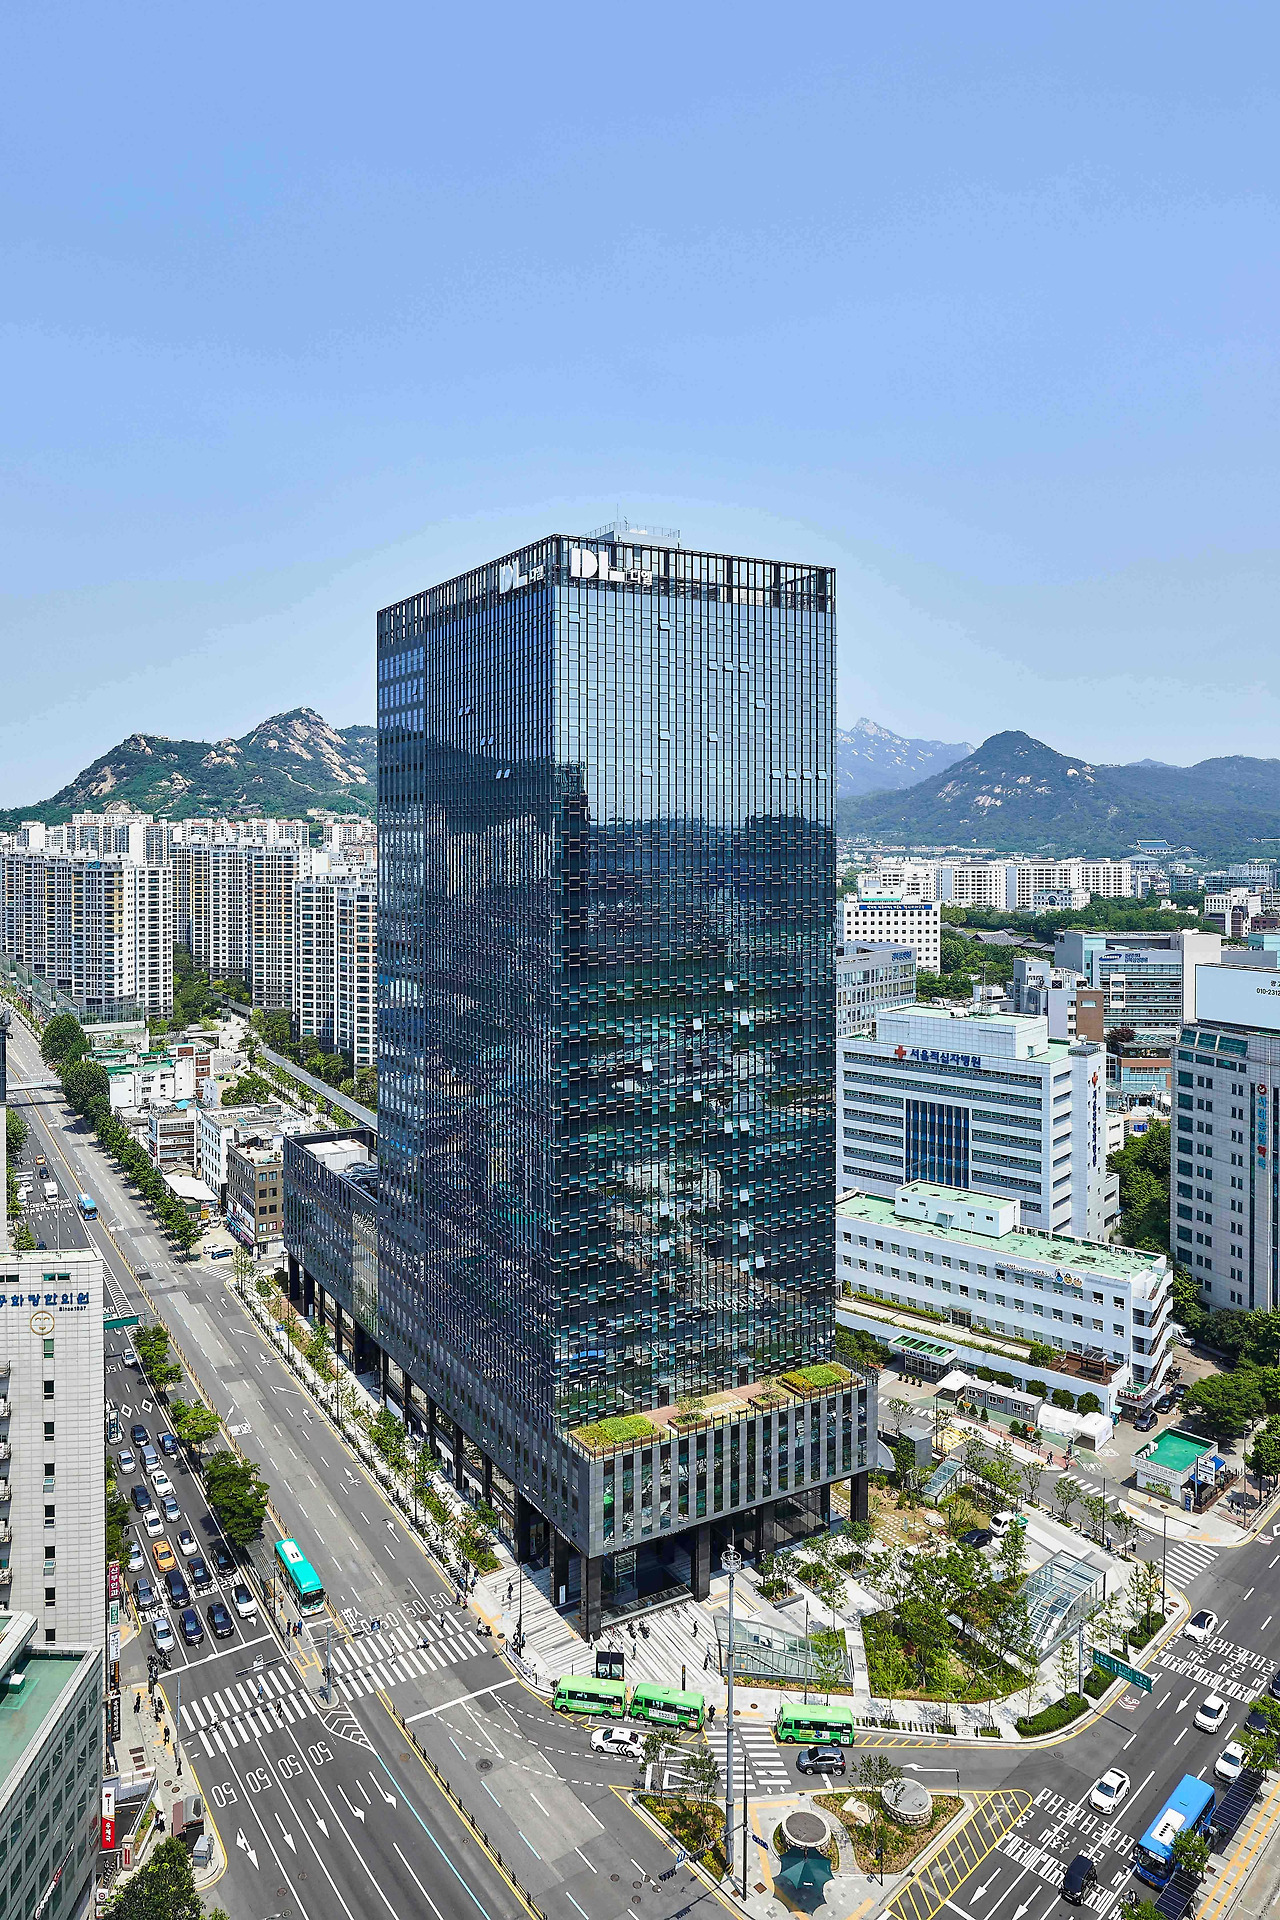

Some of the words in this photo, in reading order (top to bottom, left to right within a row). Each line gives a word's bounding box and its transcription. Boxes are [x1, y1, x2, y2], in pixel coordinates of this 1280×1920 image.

[500, 556, 528, 594] DL
[570, 548, 627, 582] DL
[630, 568, 653, 585] 디엘
[910, 1048, 982, 1069] 서울적십자병원
[402, 1600, 426, 1617] 50
[430, 1592, 453, 1608] 50
[1208, 1637, 1245, 1664] 로터리
[1241, 1650, 1278, 1674] 로터리
[308, 1741, 334, 1766] 50
[277, 1754, 304, 1779] 50
[246, 1768, 273, 1793] 50
[211, 1782, 238, 1808] 50
[1033, 1788, 1077, 1821] 로터리
[1067, 1807, 1112, 1841] 로터리
